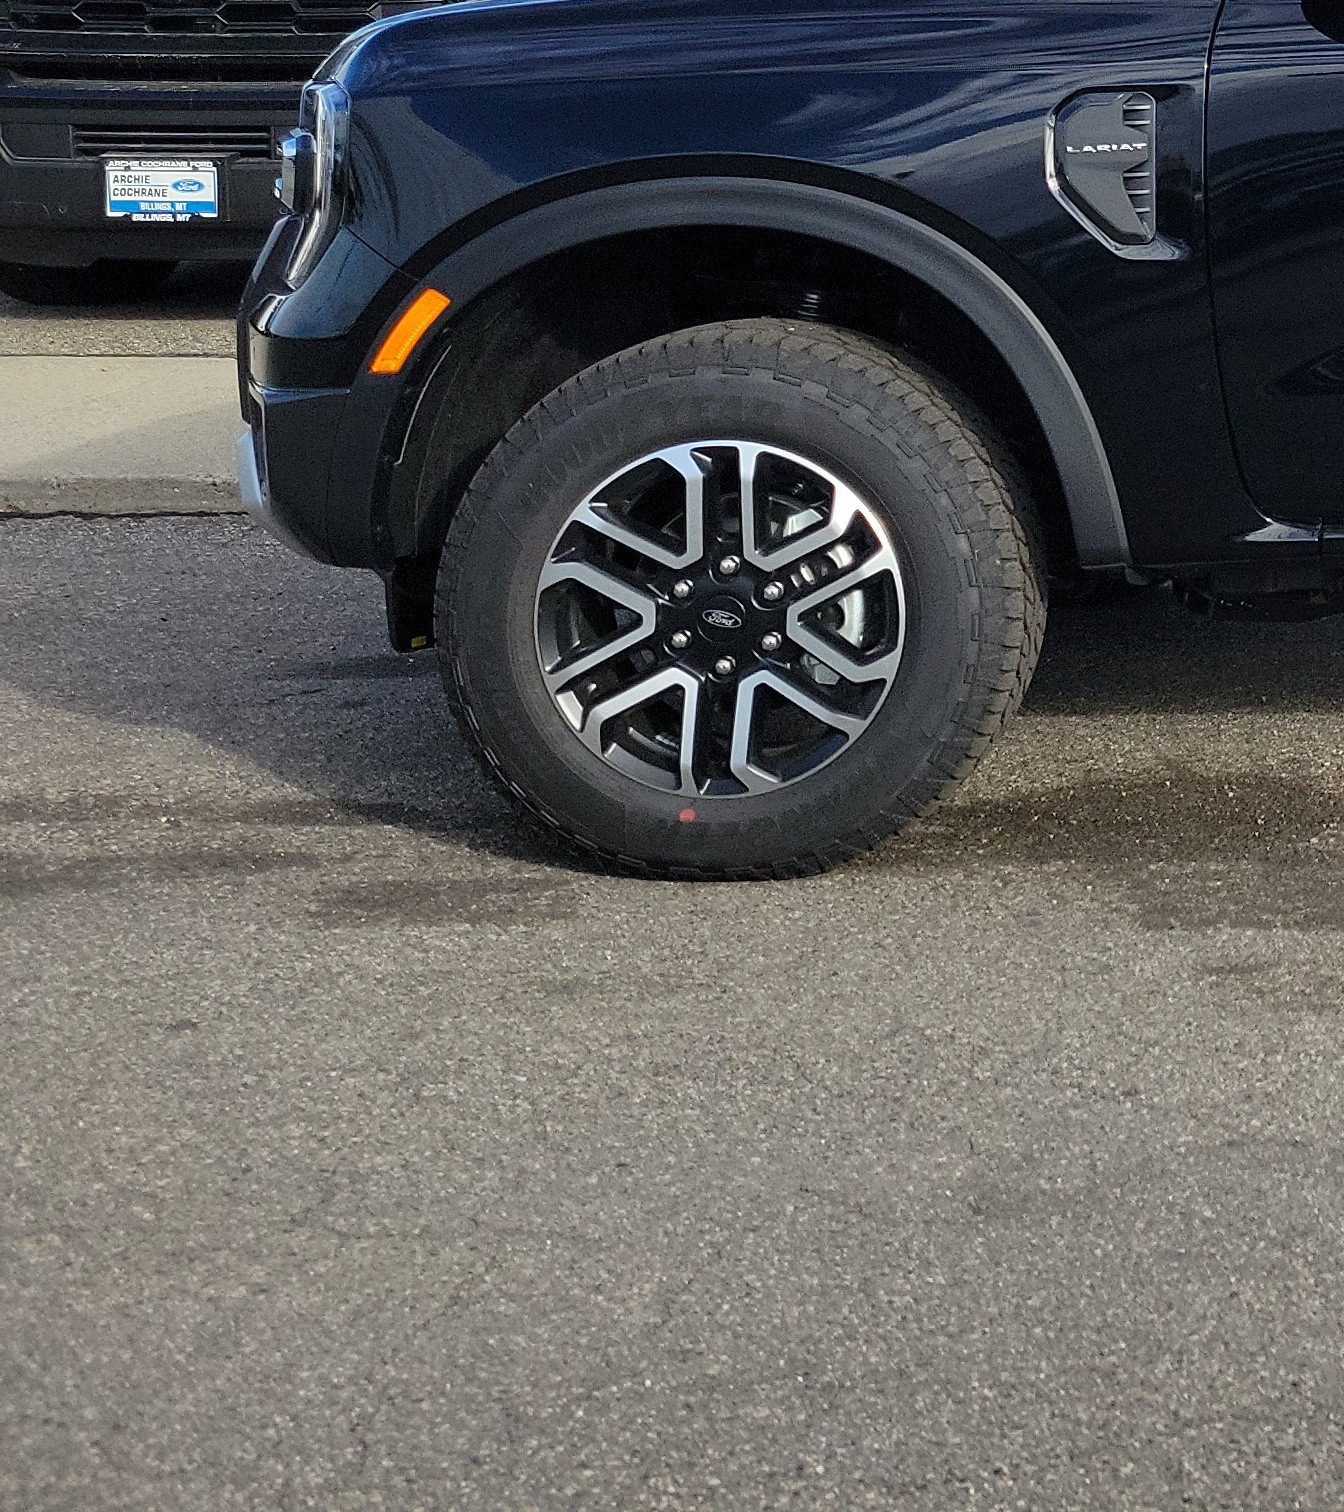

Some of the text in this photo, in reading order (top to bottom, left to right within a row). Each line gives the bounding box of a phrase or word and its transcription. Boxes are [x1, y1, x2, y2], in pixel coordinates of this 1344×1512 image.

[1066, 143, 1147, 153] LARIAT
[113, 175, 151, 184] ARCHIE
[113, 188, 168, 198] COCHRANE
